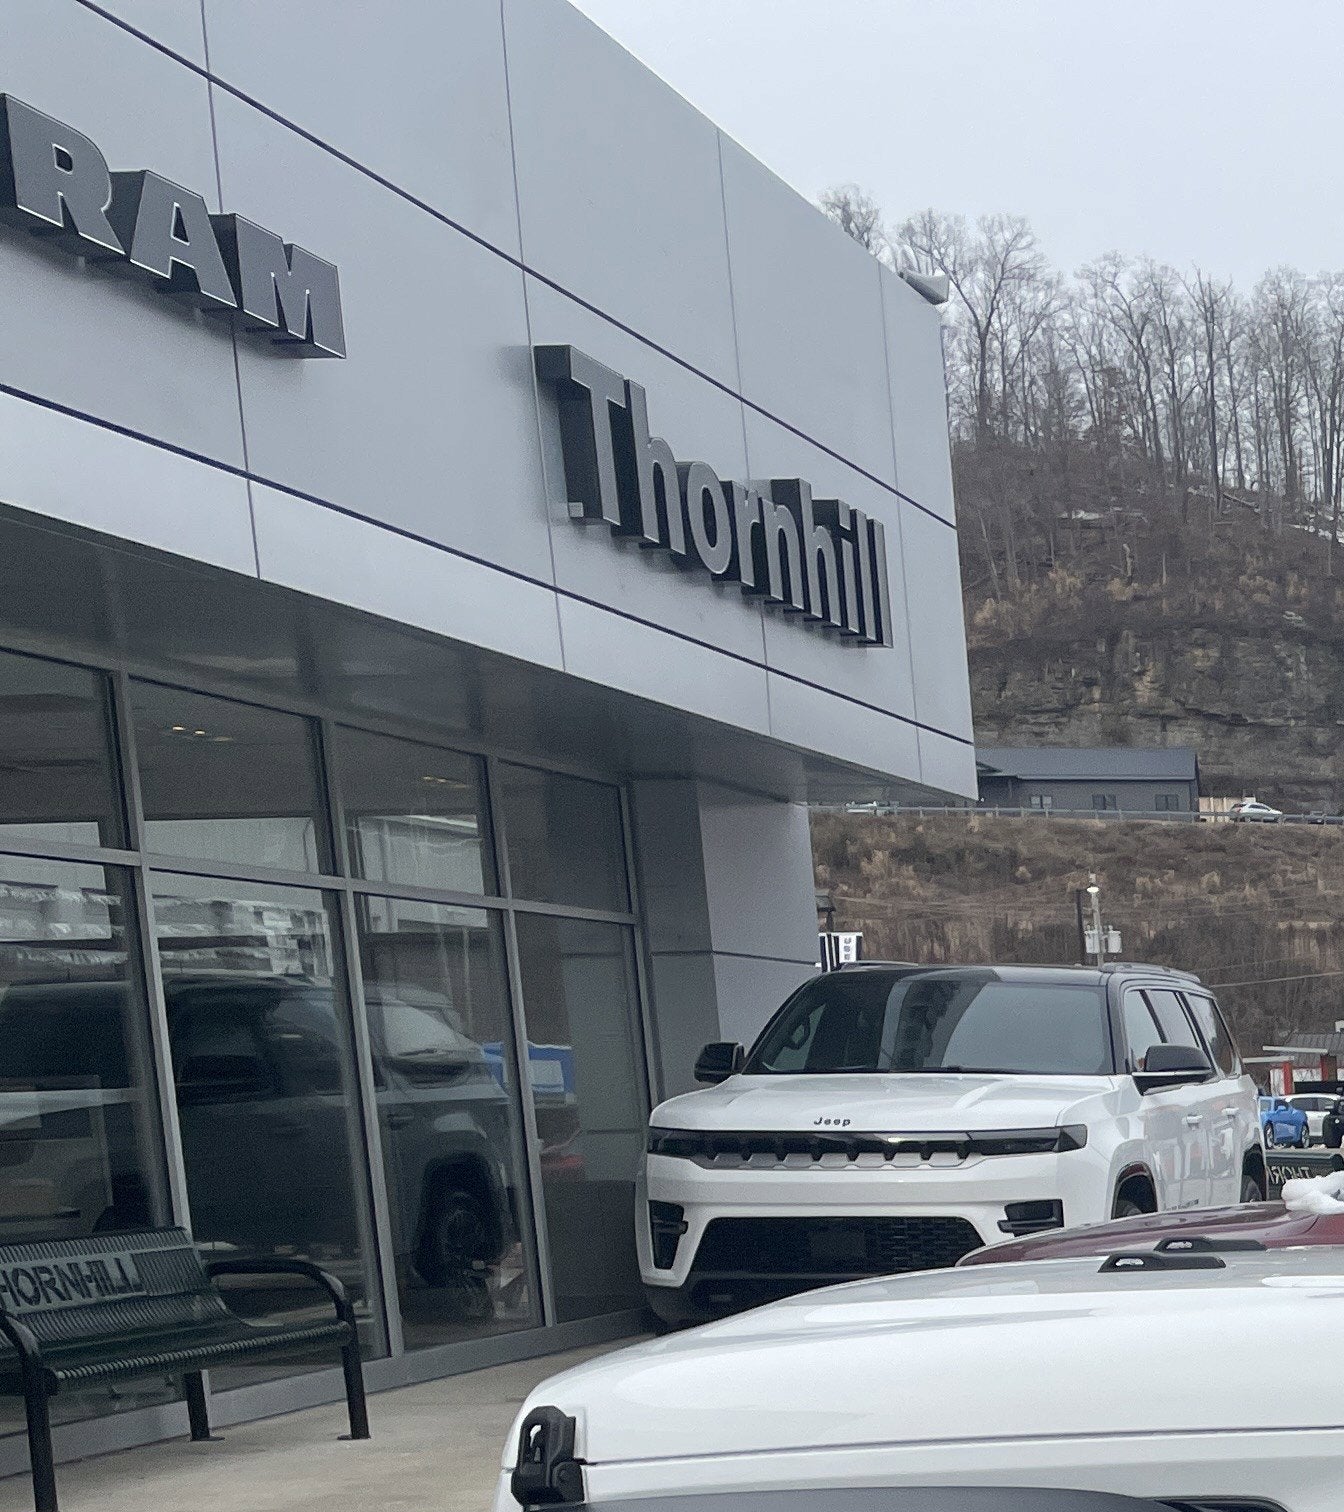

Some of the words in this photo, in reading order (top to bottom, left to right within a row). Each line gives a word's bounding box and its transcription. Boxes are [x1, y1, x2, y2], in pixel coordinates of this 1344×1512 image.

[0, 93, 346, 358] RAM
[534, 345, 893, 648] Thornhill
[813, 1116, 851, 1127] Jeep
[0, 1257, 144, 1312] HORNHILL
